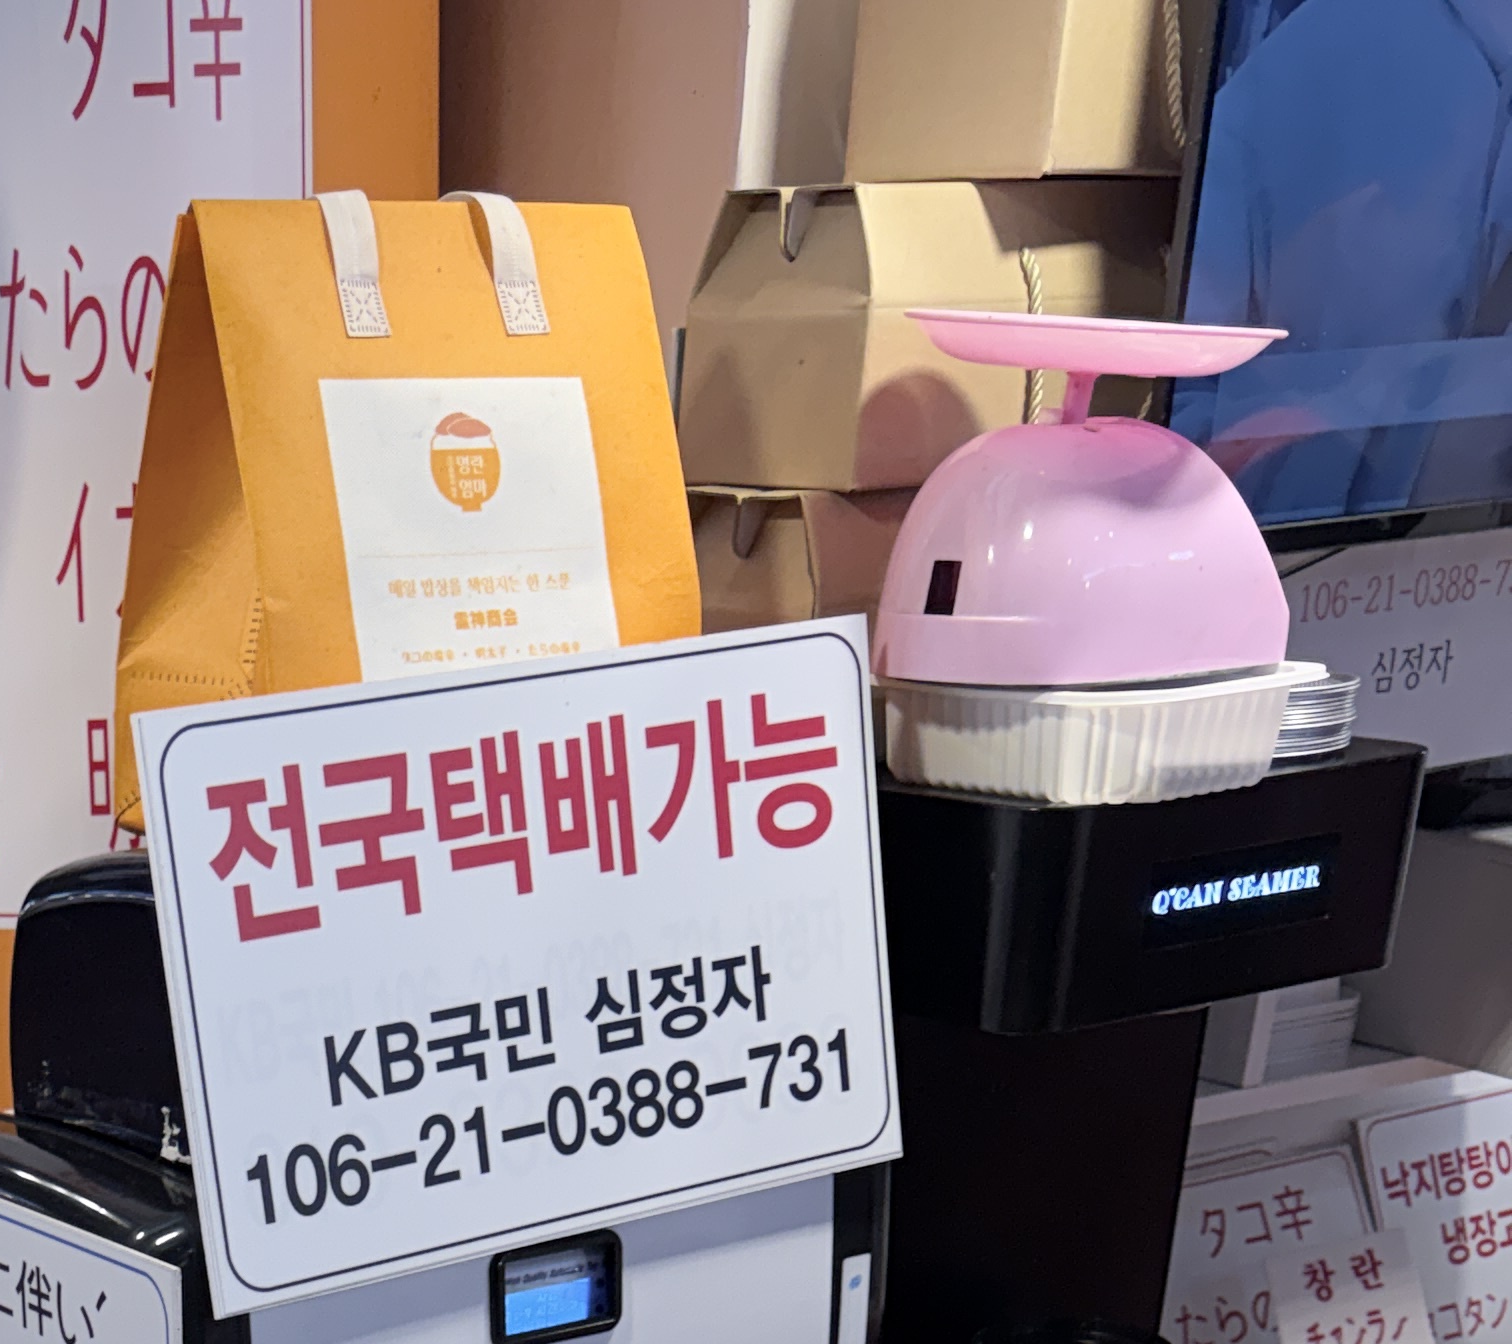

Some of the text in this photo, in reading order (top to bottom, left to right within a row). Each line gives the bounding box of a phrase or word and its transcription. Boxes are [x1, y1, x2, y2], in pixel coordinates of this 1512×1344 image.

[0, 244, 166, 391] たらの
[1299, 559, 1512, 623] 106-21-0388-7
[1371, 639, 1454, 694] 심정자
[205, 691, 839, 943] 전국택배가능
[1227, 865, 1320, 902] SEAMER
[323, 945, 771, 1108] KB국민 심정자
[246, 1026, 853, 1226] 106-21-0388-731
[1200, 1185, 1313, 1259] タコ辛
[1427, 1293, 1508, 1341] コタン
